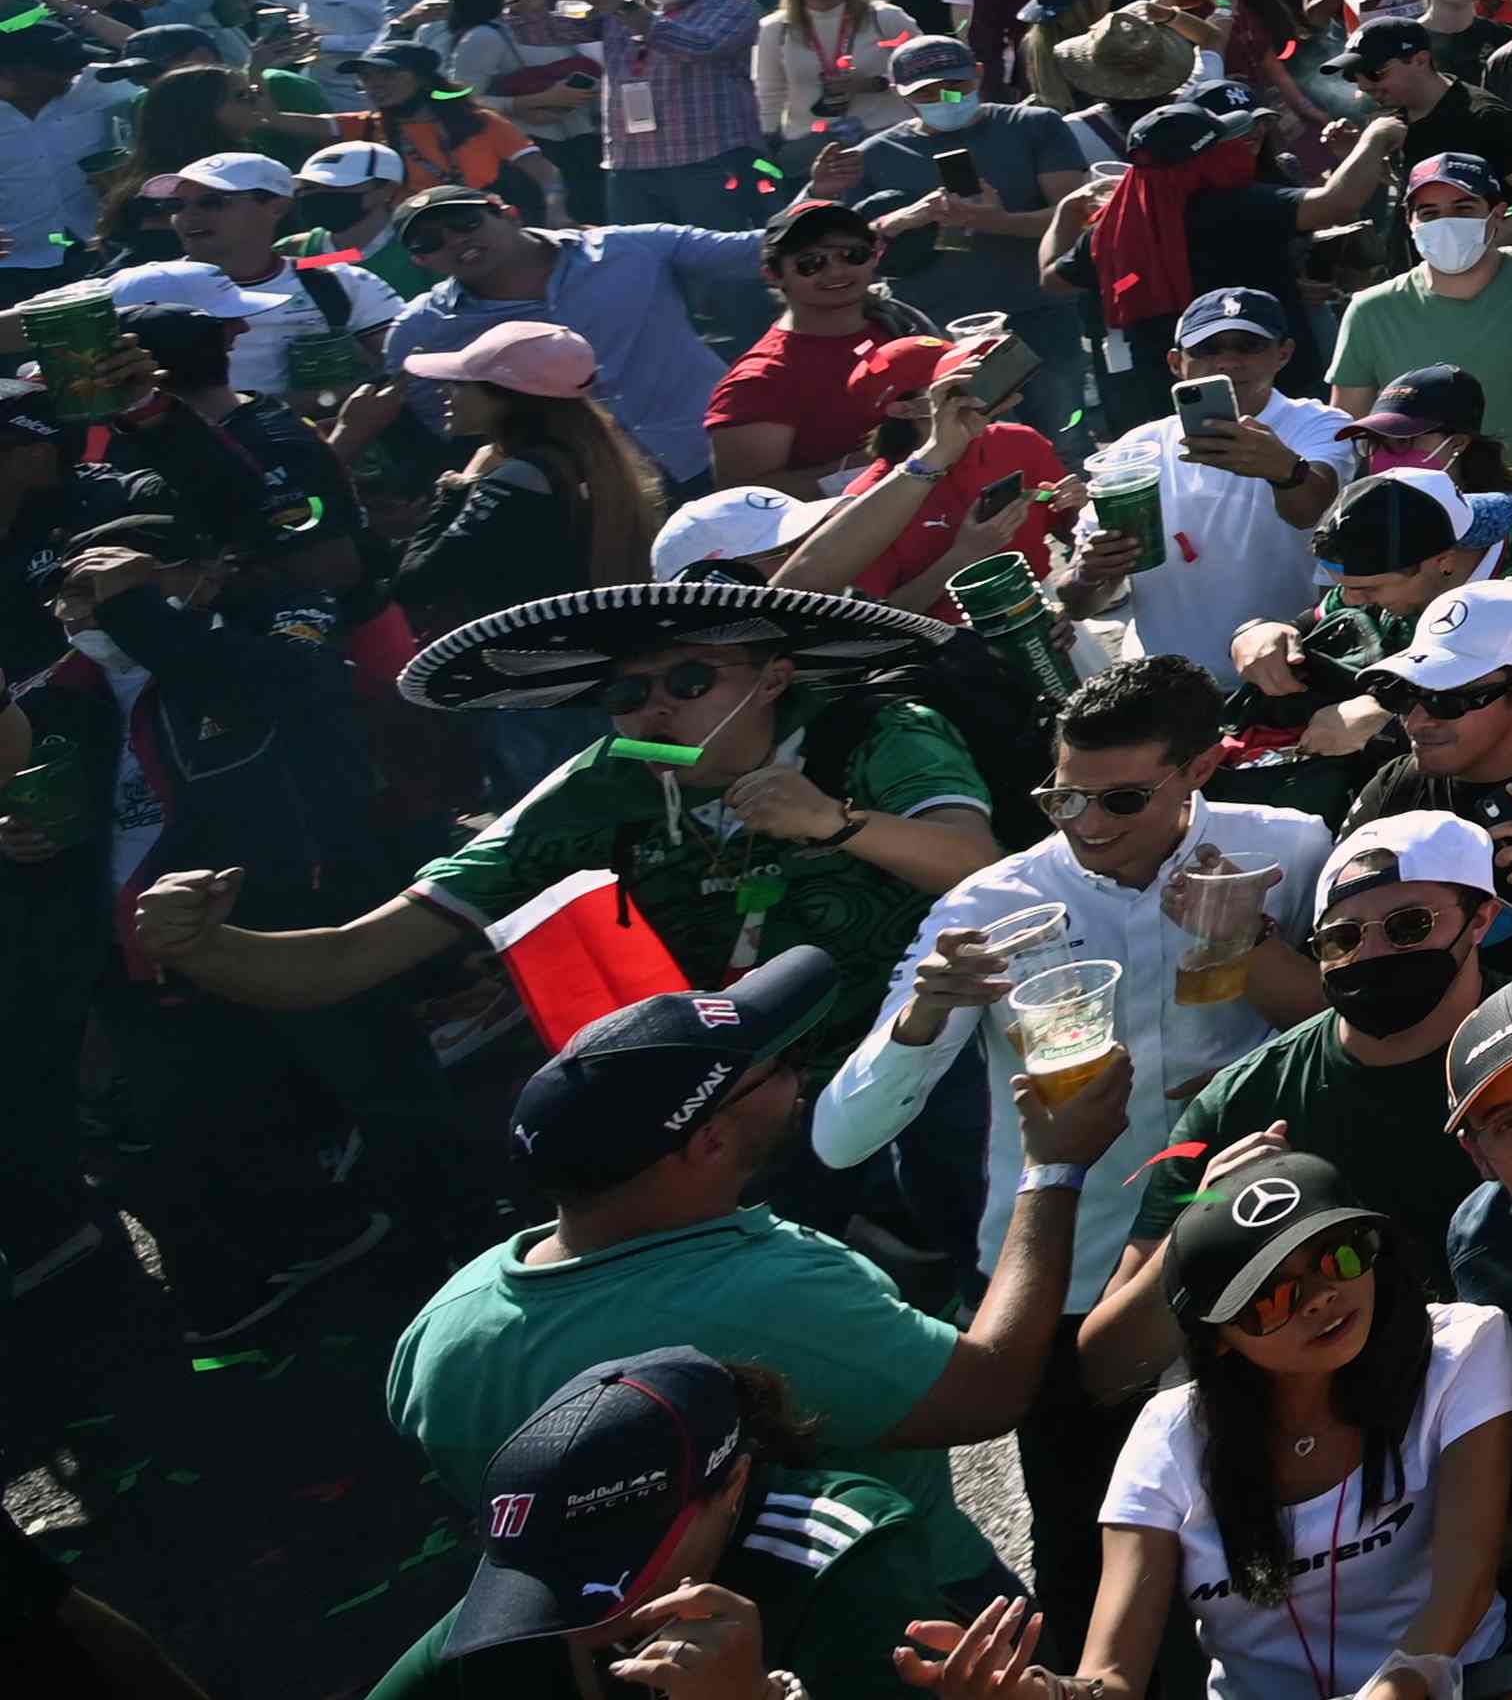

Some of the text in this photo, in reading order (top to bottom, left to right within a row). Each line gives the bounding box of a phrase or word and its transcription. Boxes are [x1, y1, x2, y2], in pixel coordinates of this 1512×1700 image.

[1024, 635, 1063, 703] eineken
[692, 997, 742, 1030] 11
[664, 1061, 735, 1133] KAVAK
[490, 1492, 538, 1540] 11
[567, 1481, 626, 1511] Red Bull
[1192, 1530, 1393, 1602] Maren
